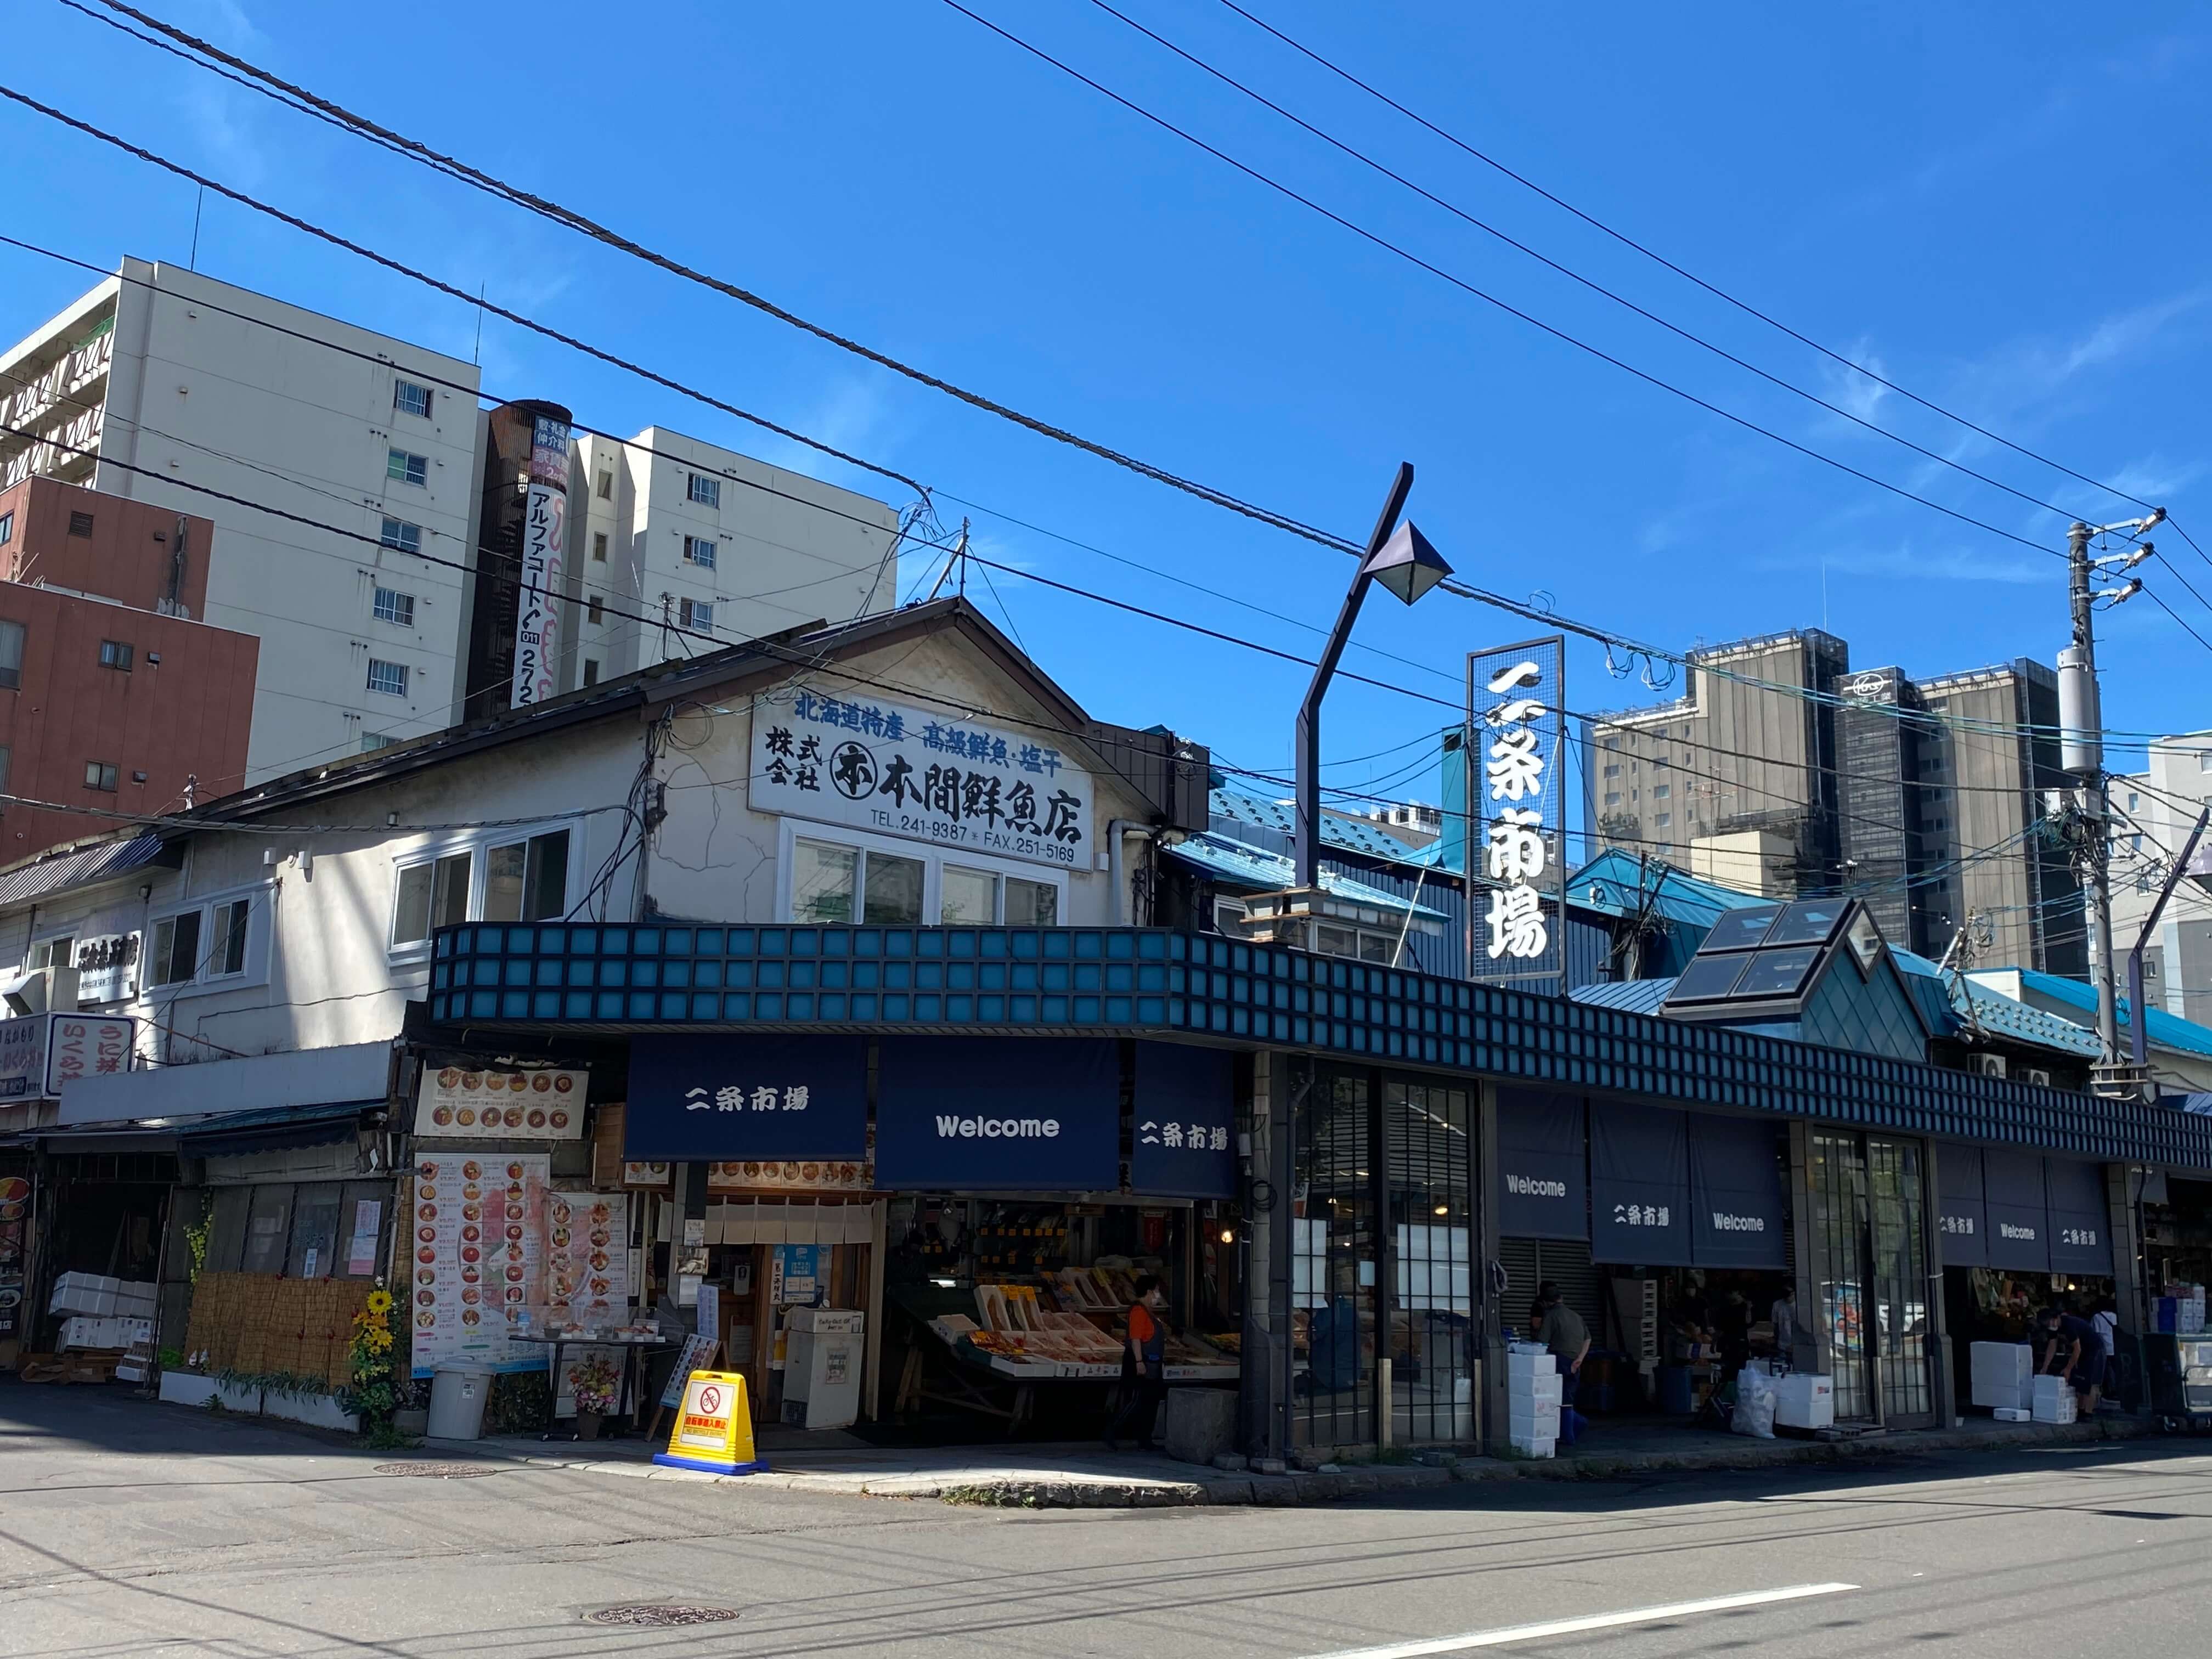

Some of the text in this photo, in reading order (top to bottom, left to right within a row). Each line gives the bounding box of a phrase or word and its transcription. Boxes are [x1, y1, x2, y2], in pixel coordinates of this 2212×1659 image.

[527, 492, 550, 608] アルファコート
[522, 633, 538, 644] 011
[795, 692, 905, 742] 北海道特産
[766, 726, 822, 766] 株式
[765, 757, 820, 793] 会社
[879, 755, 1082, 845] 本間鮮魚店
[1486, 661, 1547, 958] 二条市場
[984, 832, 1075, 862] FAX.251-5169
[95, 1025, 122, 1073] うに丼
[685, 1086, 809, 1111] 二条市場
[936, 1115, 1060, 1137] Welcome
[1140, 1121, 1228, 1150] 二条市場
[1506, 1174, 1566, 1198] Welcome
[1614, 1204, 1669, 1227] 二条市場
[1713, 1212, 1764, 1232] Welcome
[2001, 1223, 2035, 1240] Welcome
[2062, 1228, 2096, 1246] 二条市場
